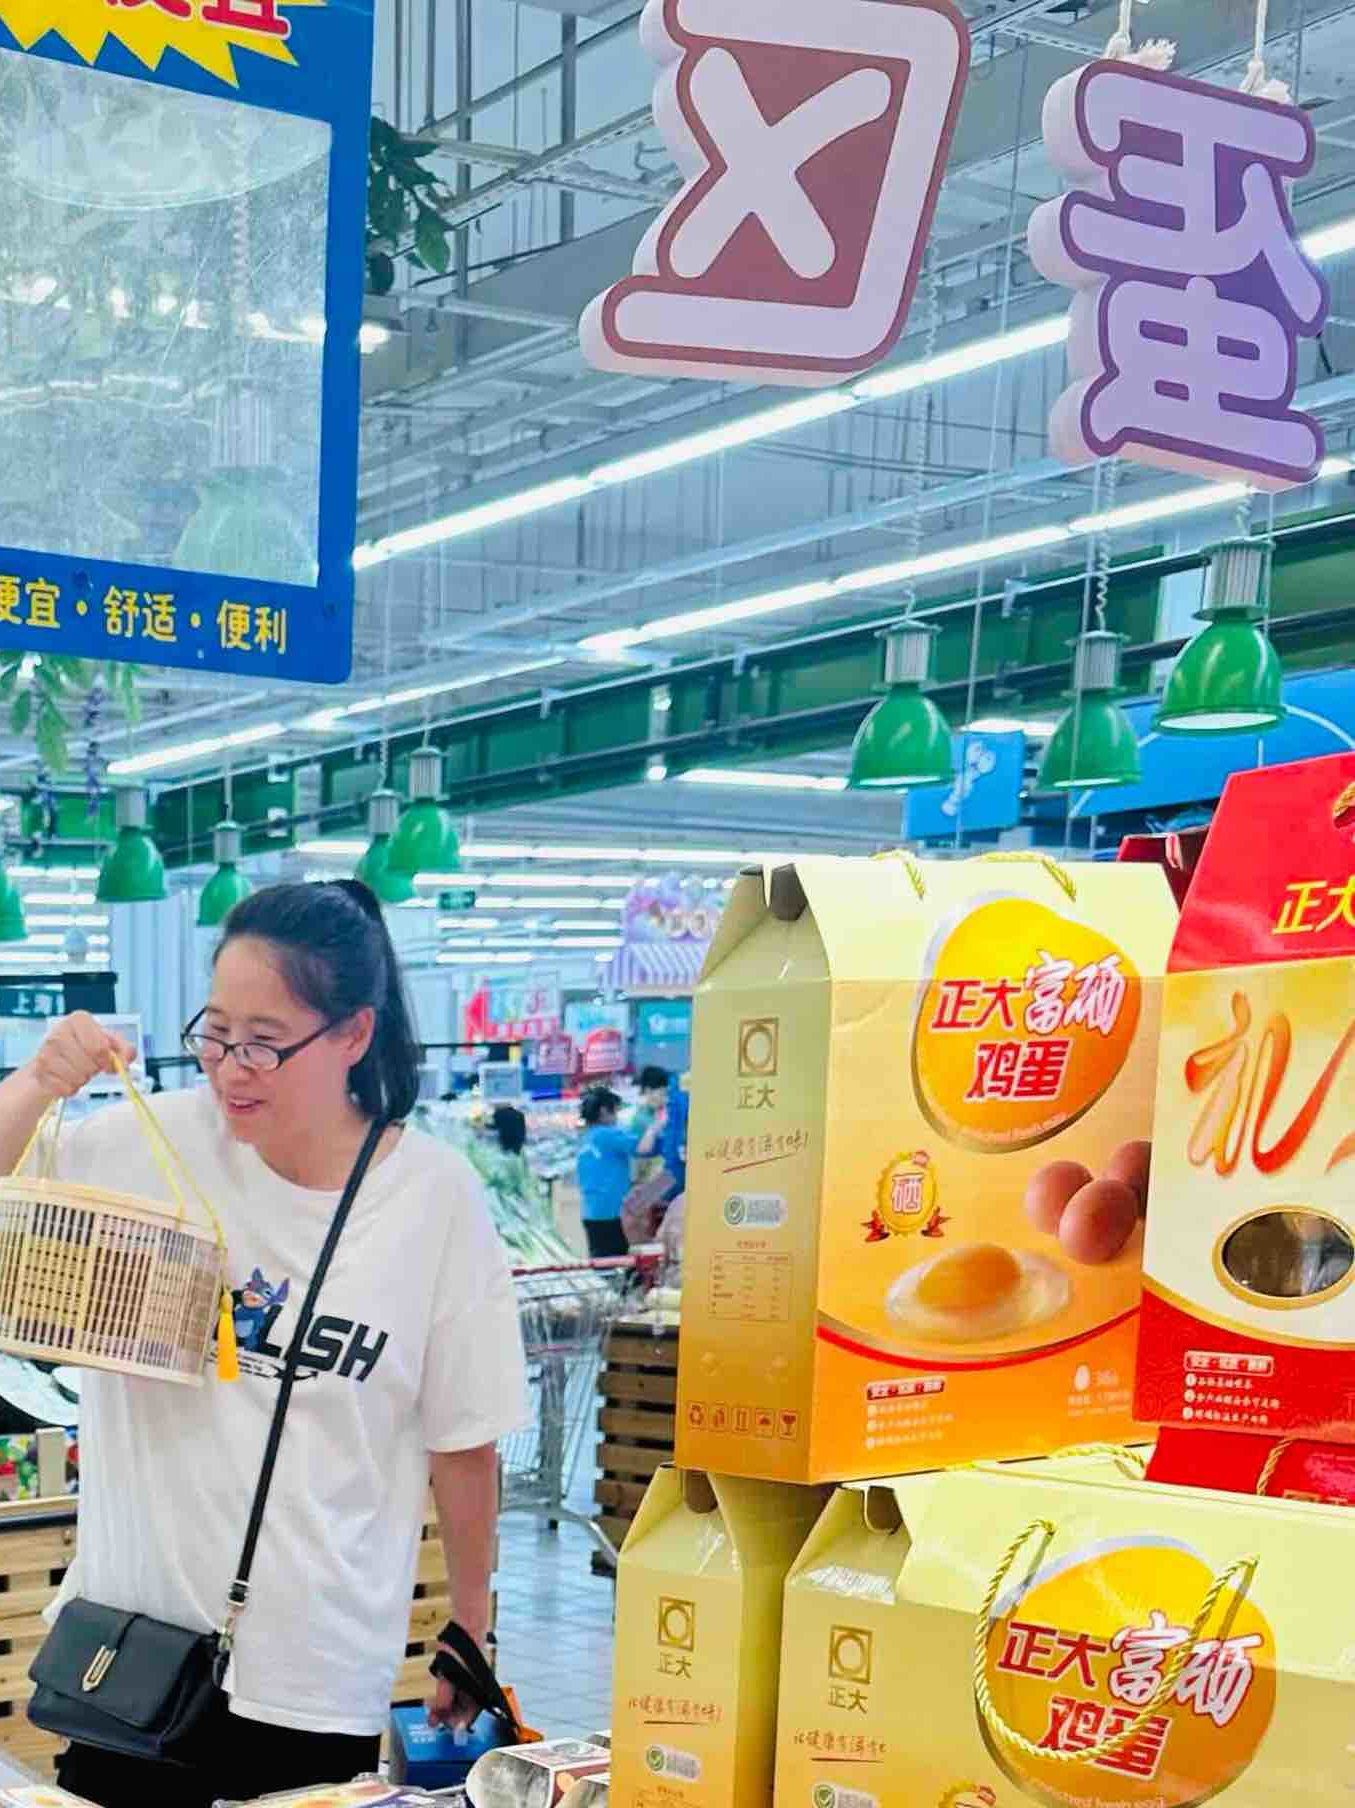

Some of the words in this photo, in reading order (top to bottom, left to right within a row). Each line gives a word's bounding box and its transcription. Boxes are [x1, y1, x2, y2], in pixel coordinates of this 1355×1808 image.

[964, 1039, 1071, 1102] 鸡蛋
[737, 1083, 776, 1110] 正大
[656, 1653, 694, 1680] 正大
[828, 1687, 869, 1714] 正大
[1038, 1694, 1173, 1782] 鸡蛋
